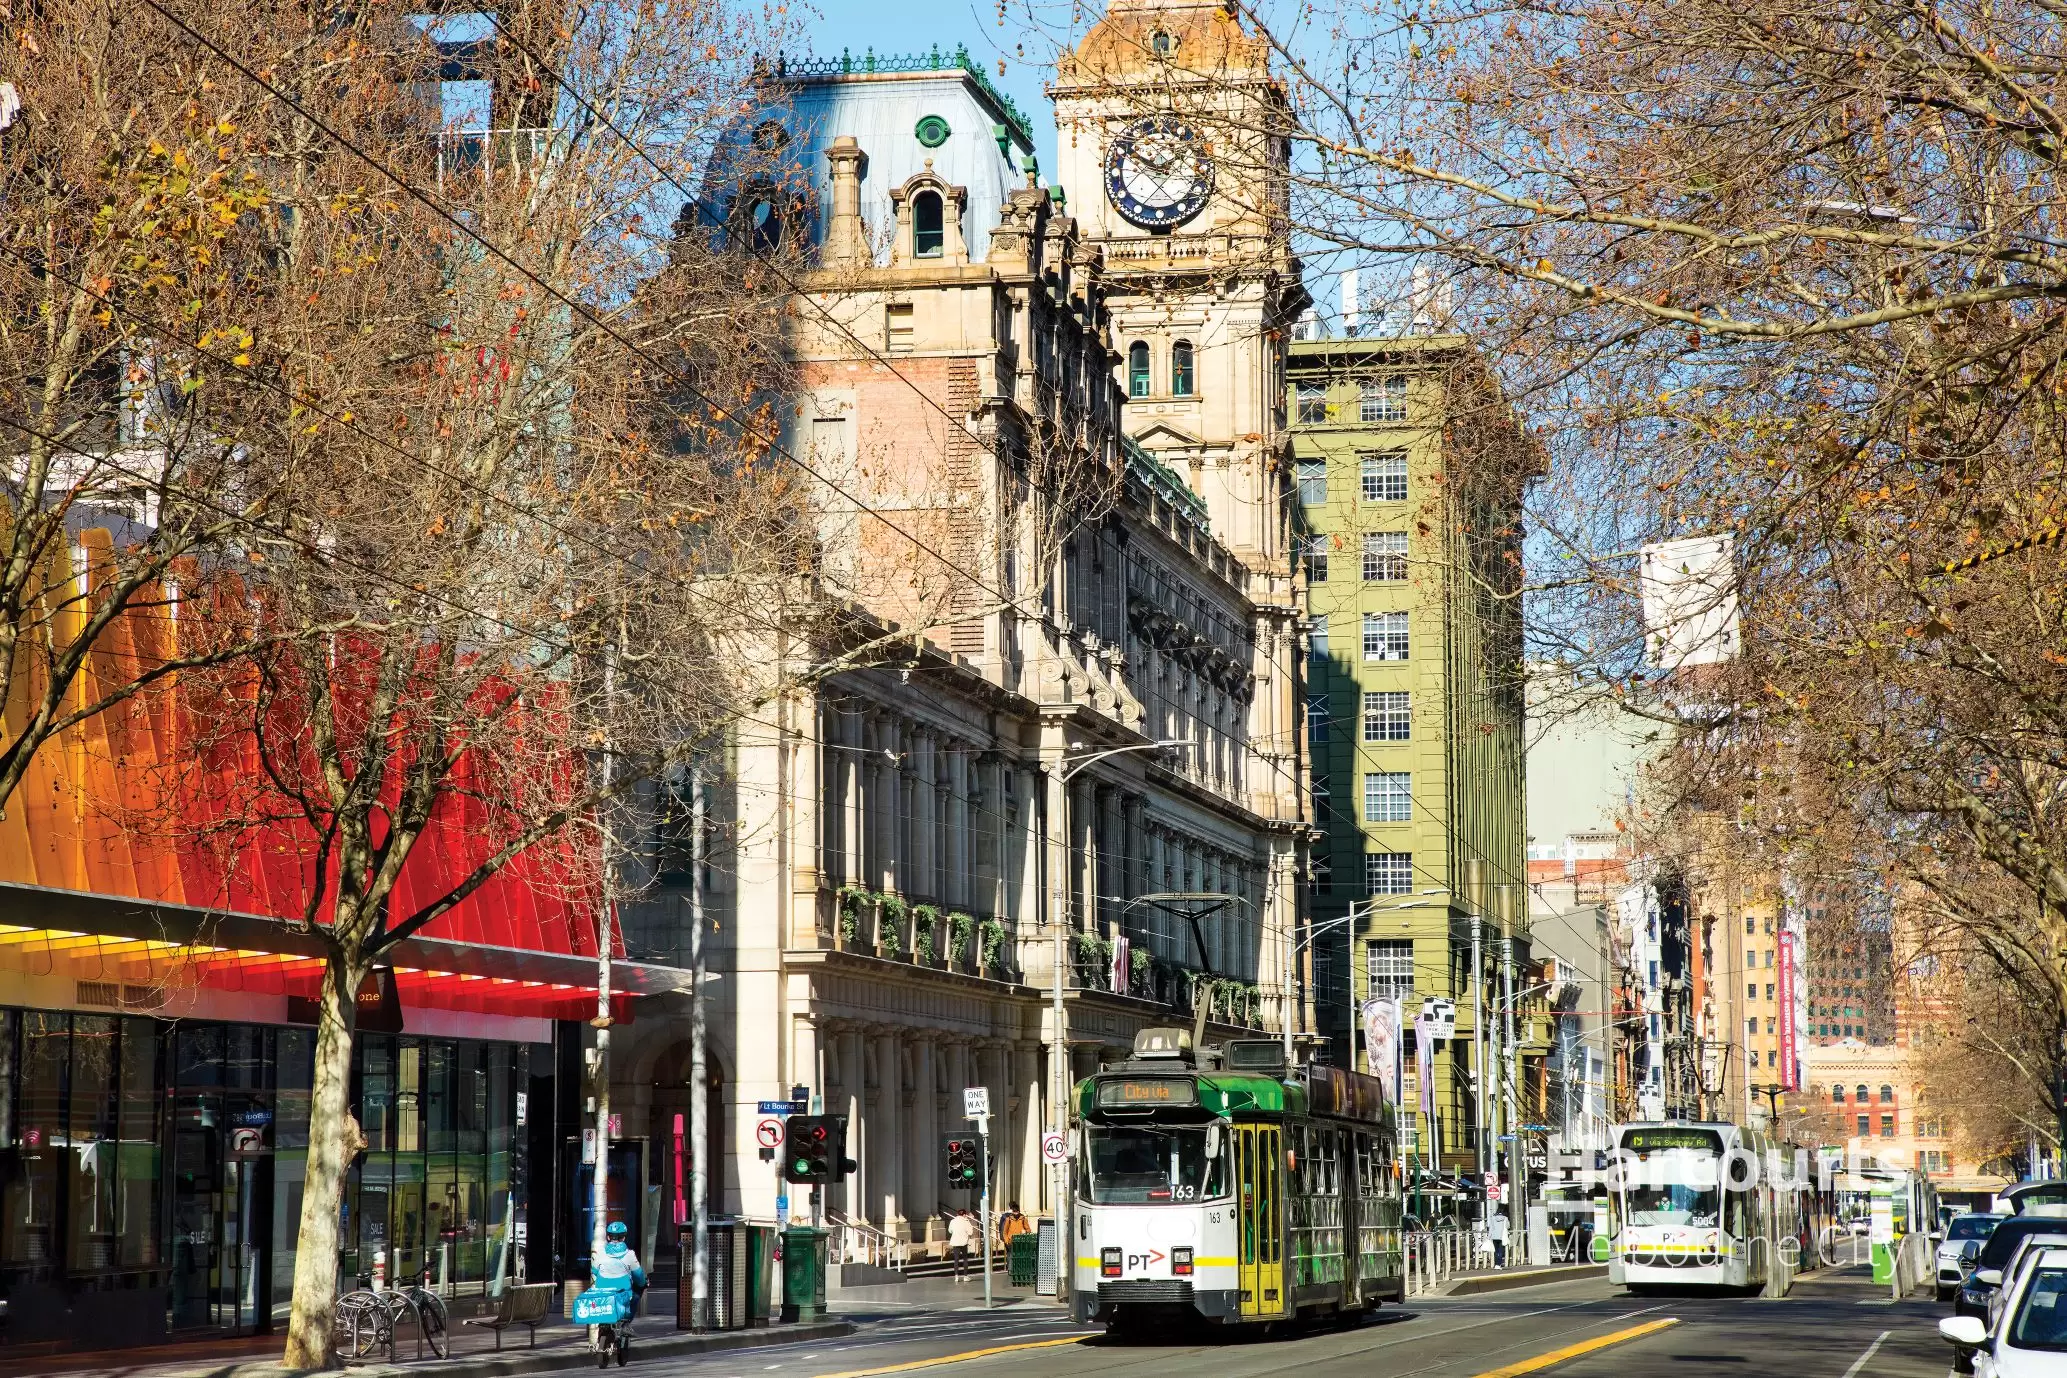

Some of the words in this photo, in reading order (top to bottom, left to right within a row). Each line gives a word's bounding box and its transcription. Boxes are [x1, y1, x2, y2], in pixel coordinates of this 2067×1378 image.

[968, 1090, 984, 1099] ONE
[1124, 1084, 1149, 1099] City
[1152, 1086, 1169, 1098] via
[796, 1102, 804, 1110] St
[967, 1100, 986, 1109] WAY
[1046, 1141, 1064, 1154] 40
[1169, 1185, 1195, 1199] 163
[1209, 1212, 1221, 1224] 163
[370, 1223, 384, 1235] SALE
